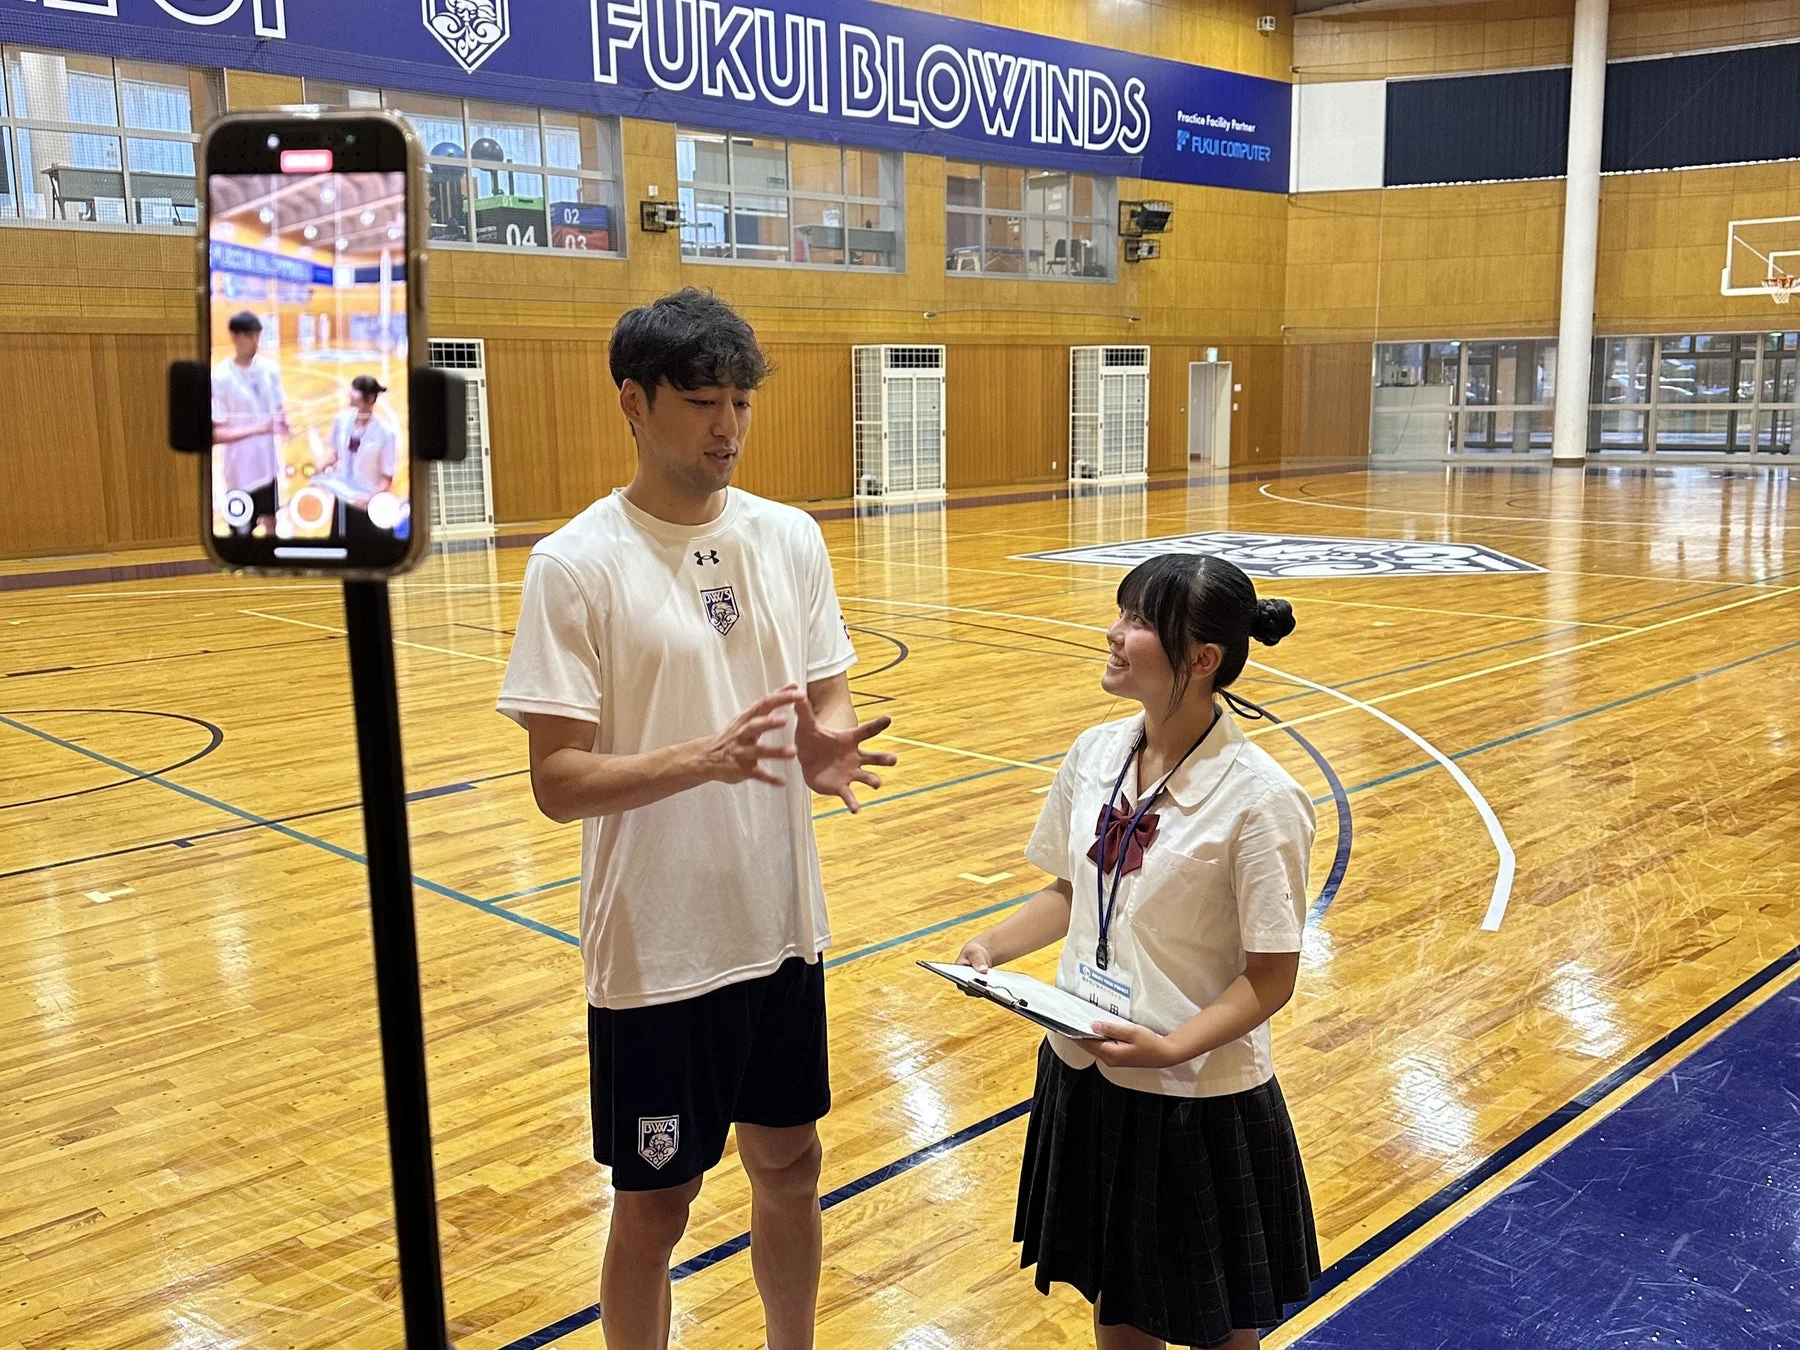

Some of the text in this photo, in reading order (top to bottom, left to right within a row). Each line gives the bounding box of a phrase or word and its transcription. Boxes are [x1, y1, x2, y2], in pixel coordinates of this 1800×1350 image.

[591, 0, 1151, 154] FUKUI BLOWINDS
[1177, 110, 1256, 132] Practice Facility Partner
[1192, 136, 1271, 162] FUKUI COMPUTER
[564, 208, 580, 224] 02
[506, 224, 537, 246] 04
[644, 1121, 675, 1133] BWS
